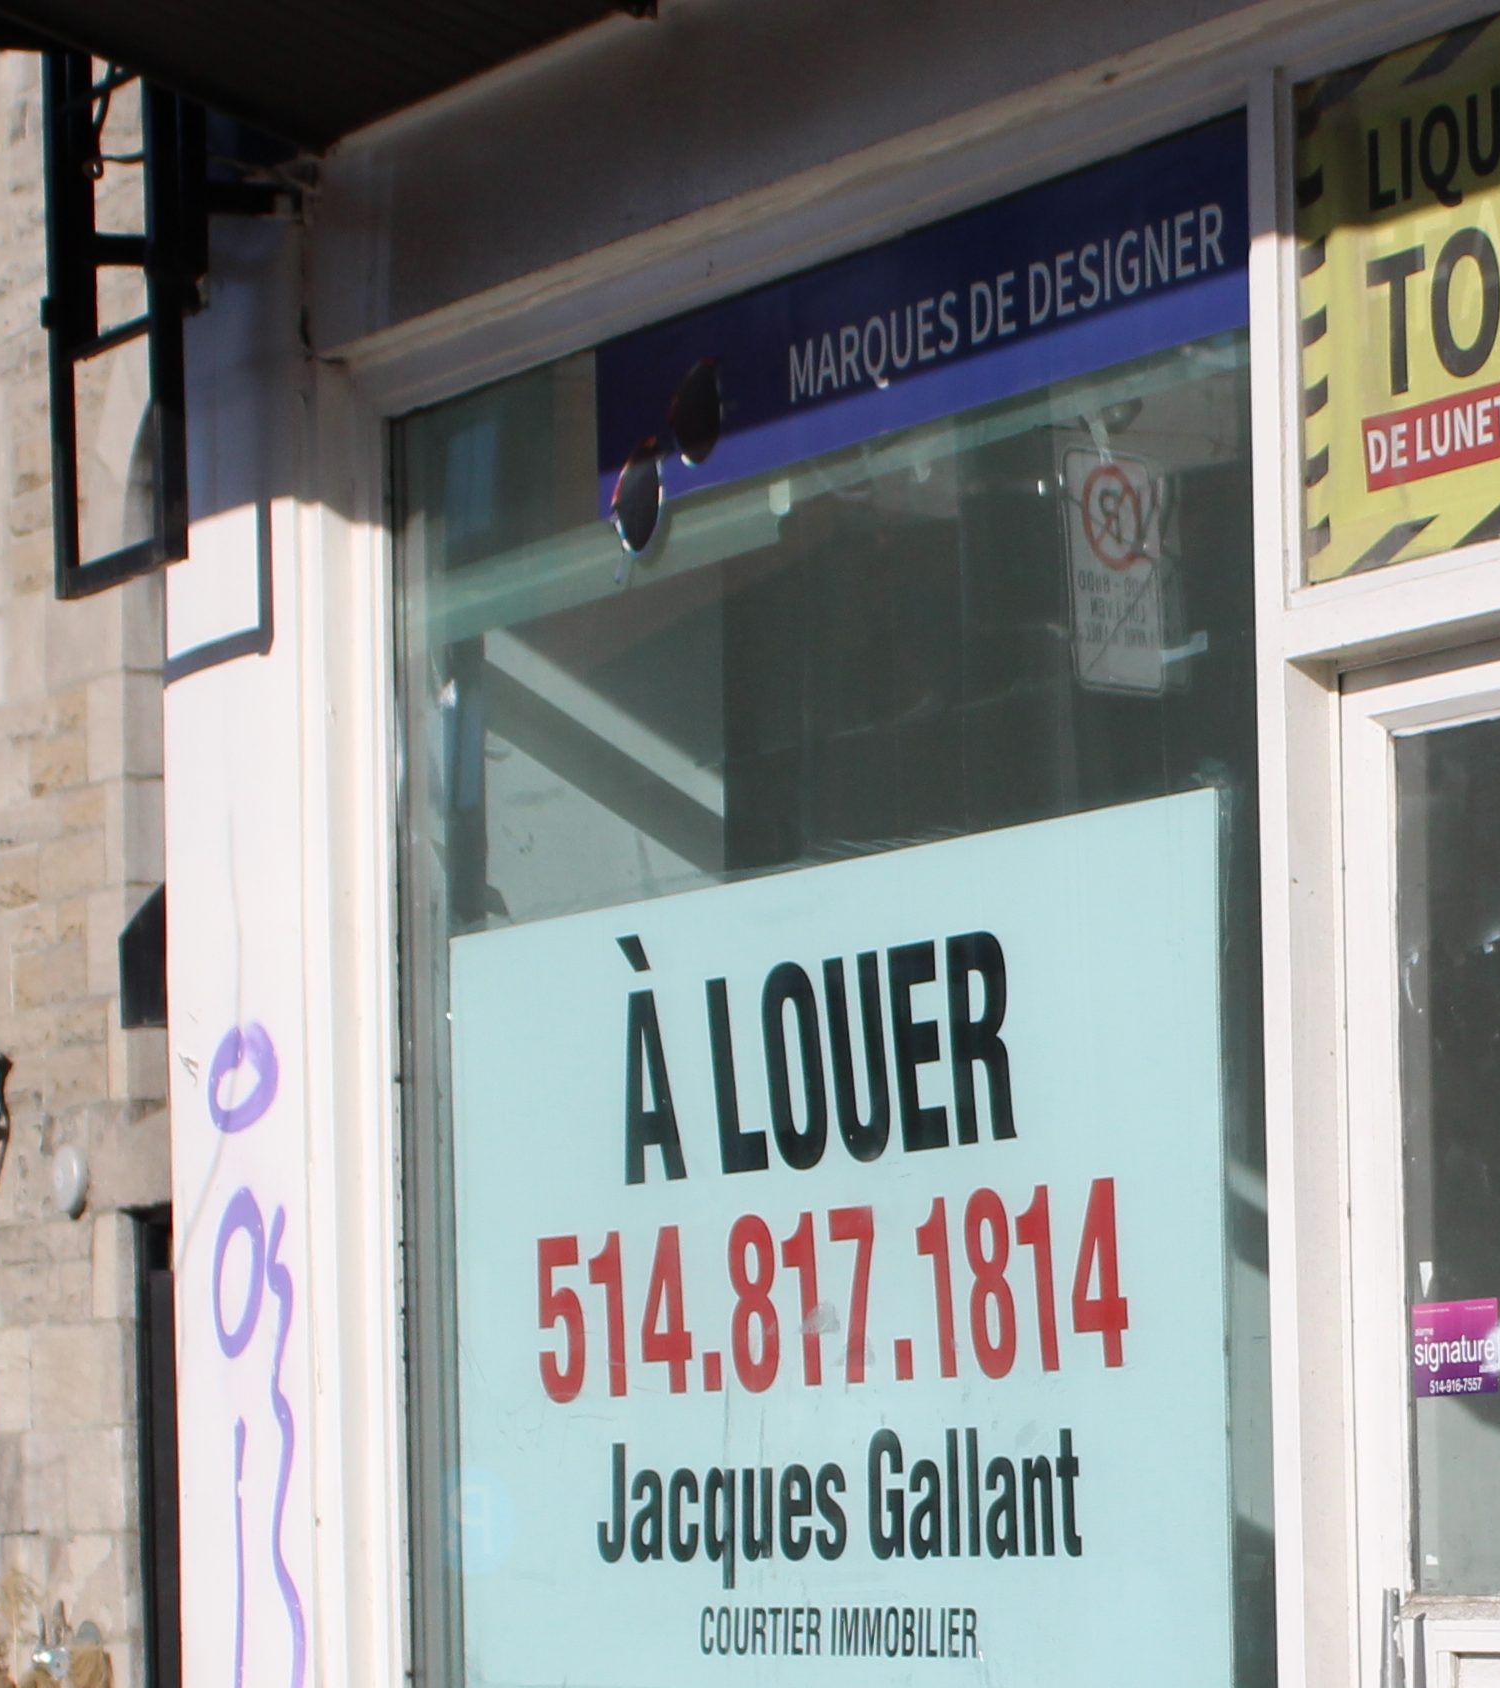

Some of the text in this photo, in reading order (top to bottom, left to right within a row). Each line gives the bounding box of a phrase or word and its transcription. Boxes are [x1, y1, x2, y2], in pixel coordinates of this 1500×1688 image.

[789, 203, 1225, 402] MARQUES DE DESIGNER
[1367, 423, 1407, 474] DE
[615, 930, 1018, 1186] À LOUER
[537, 1176, 1130, 1404] 514.817.1814
[1414, 1333, 1495, 1373] signature
[596, 1427, 1083, 1591] Jacques Gallant
[699, 1606, 978, 1659] COURTIER IMMOBILIER
